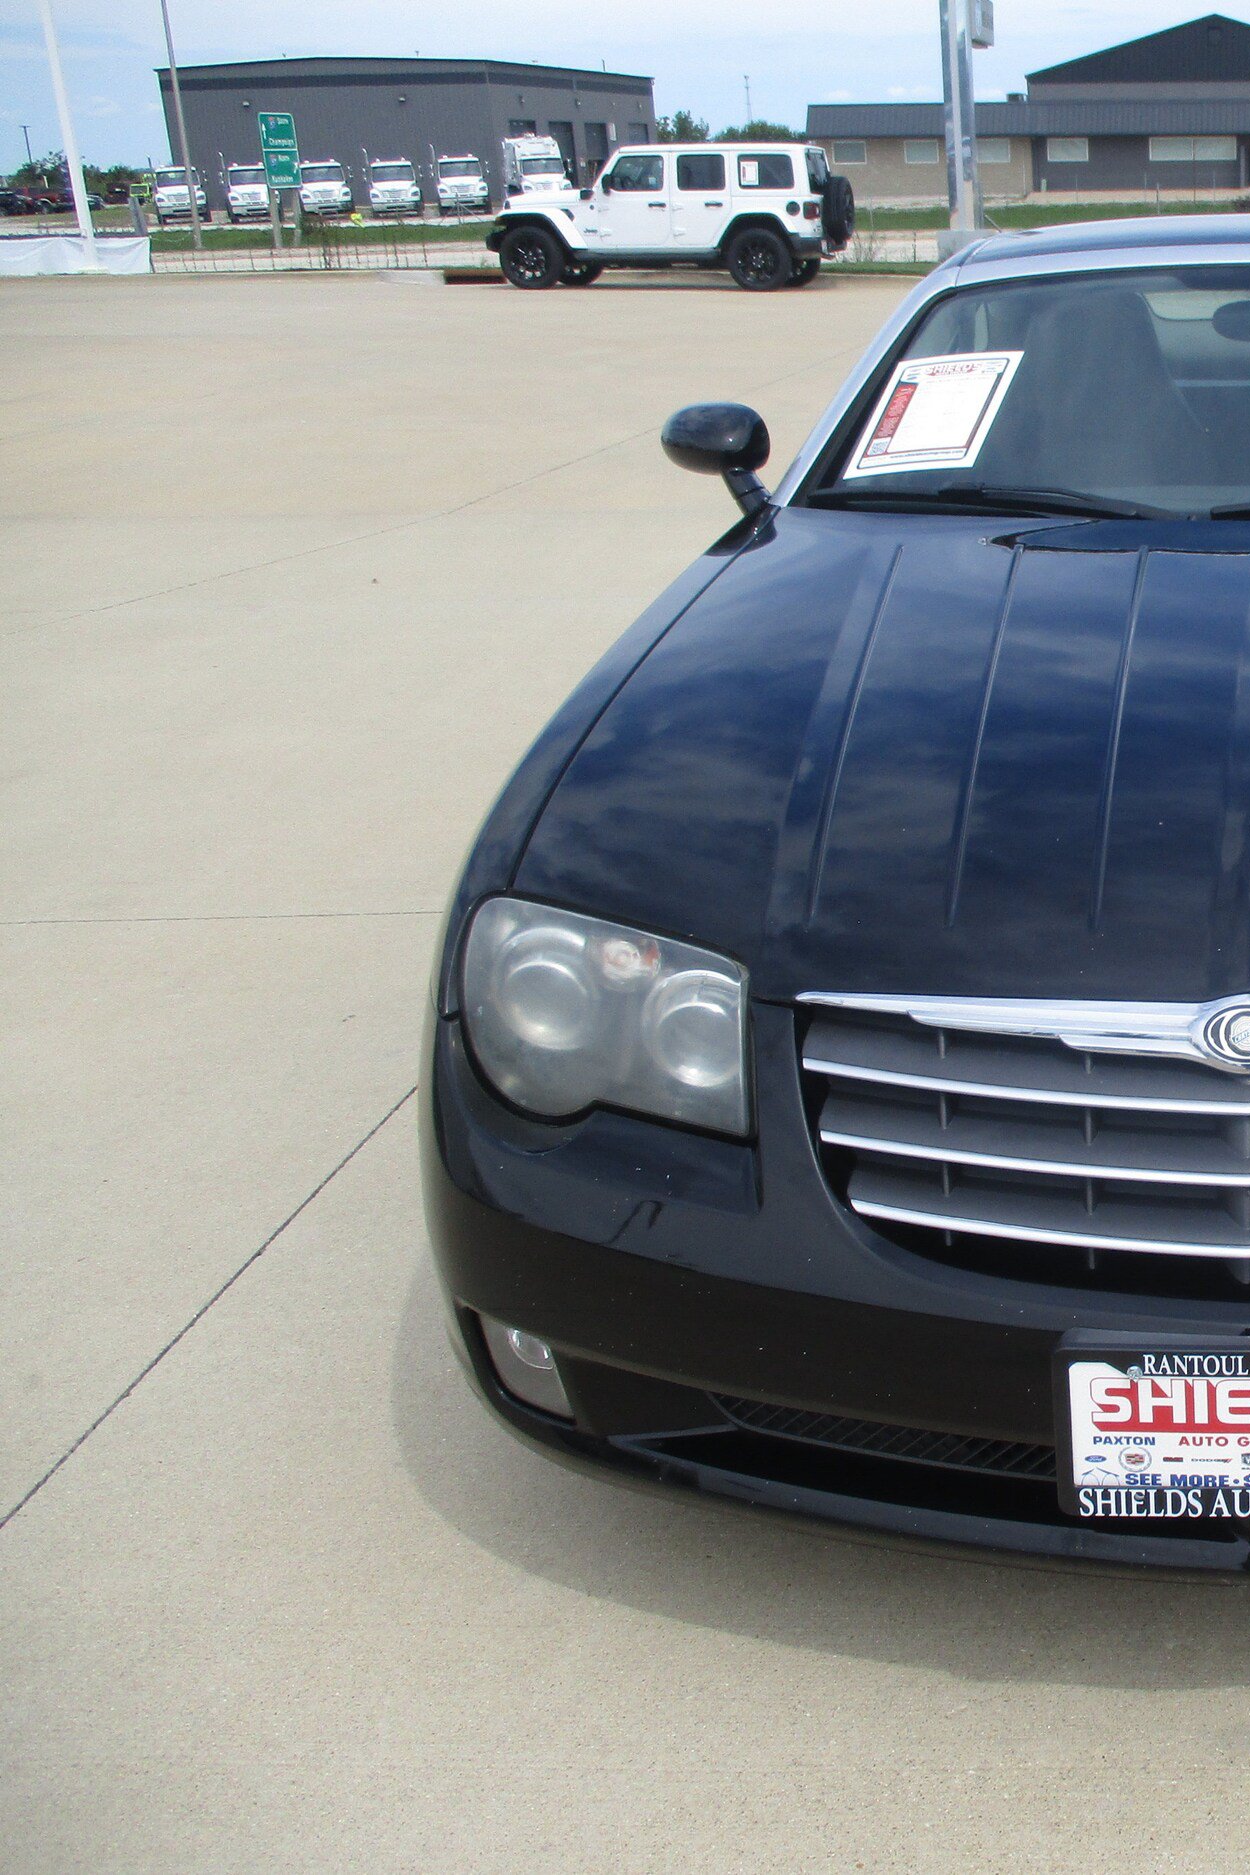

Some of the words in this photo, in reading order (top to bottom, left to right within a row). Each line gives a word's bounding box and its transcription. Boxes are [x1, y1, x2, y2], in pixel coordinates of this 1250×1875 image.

[1142, 1354, 1249, 1376] RANTOUL
[1093, 1436, 1156, 1446] PAXTON
[1178, 1436, 1229, 1447] AUTO
[1125, 1473, 1162, 1487] SEE
[1170, 1474, 1230, 1487] MORE
[1079, 1488, 1204, 1518] SHIELDS
